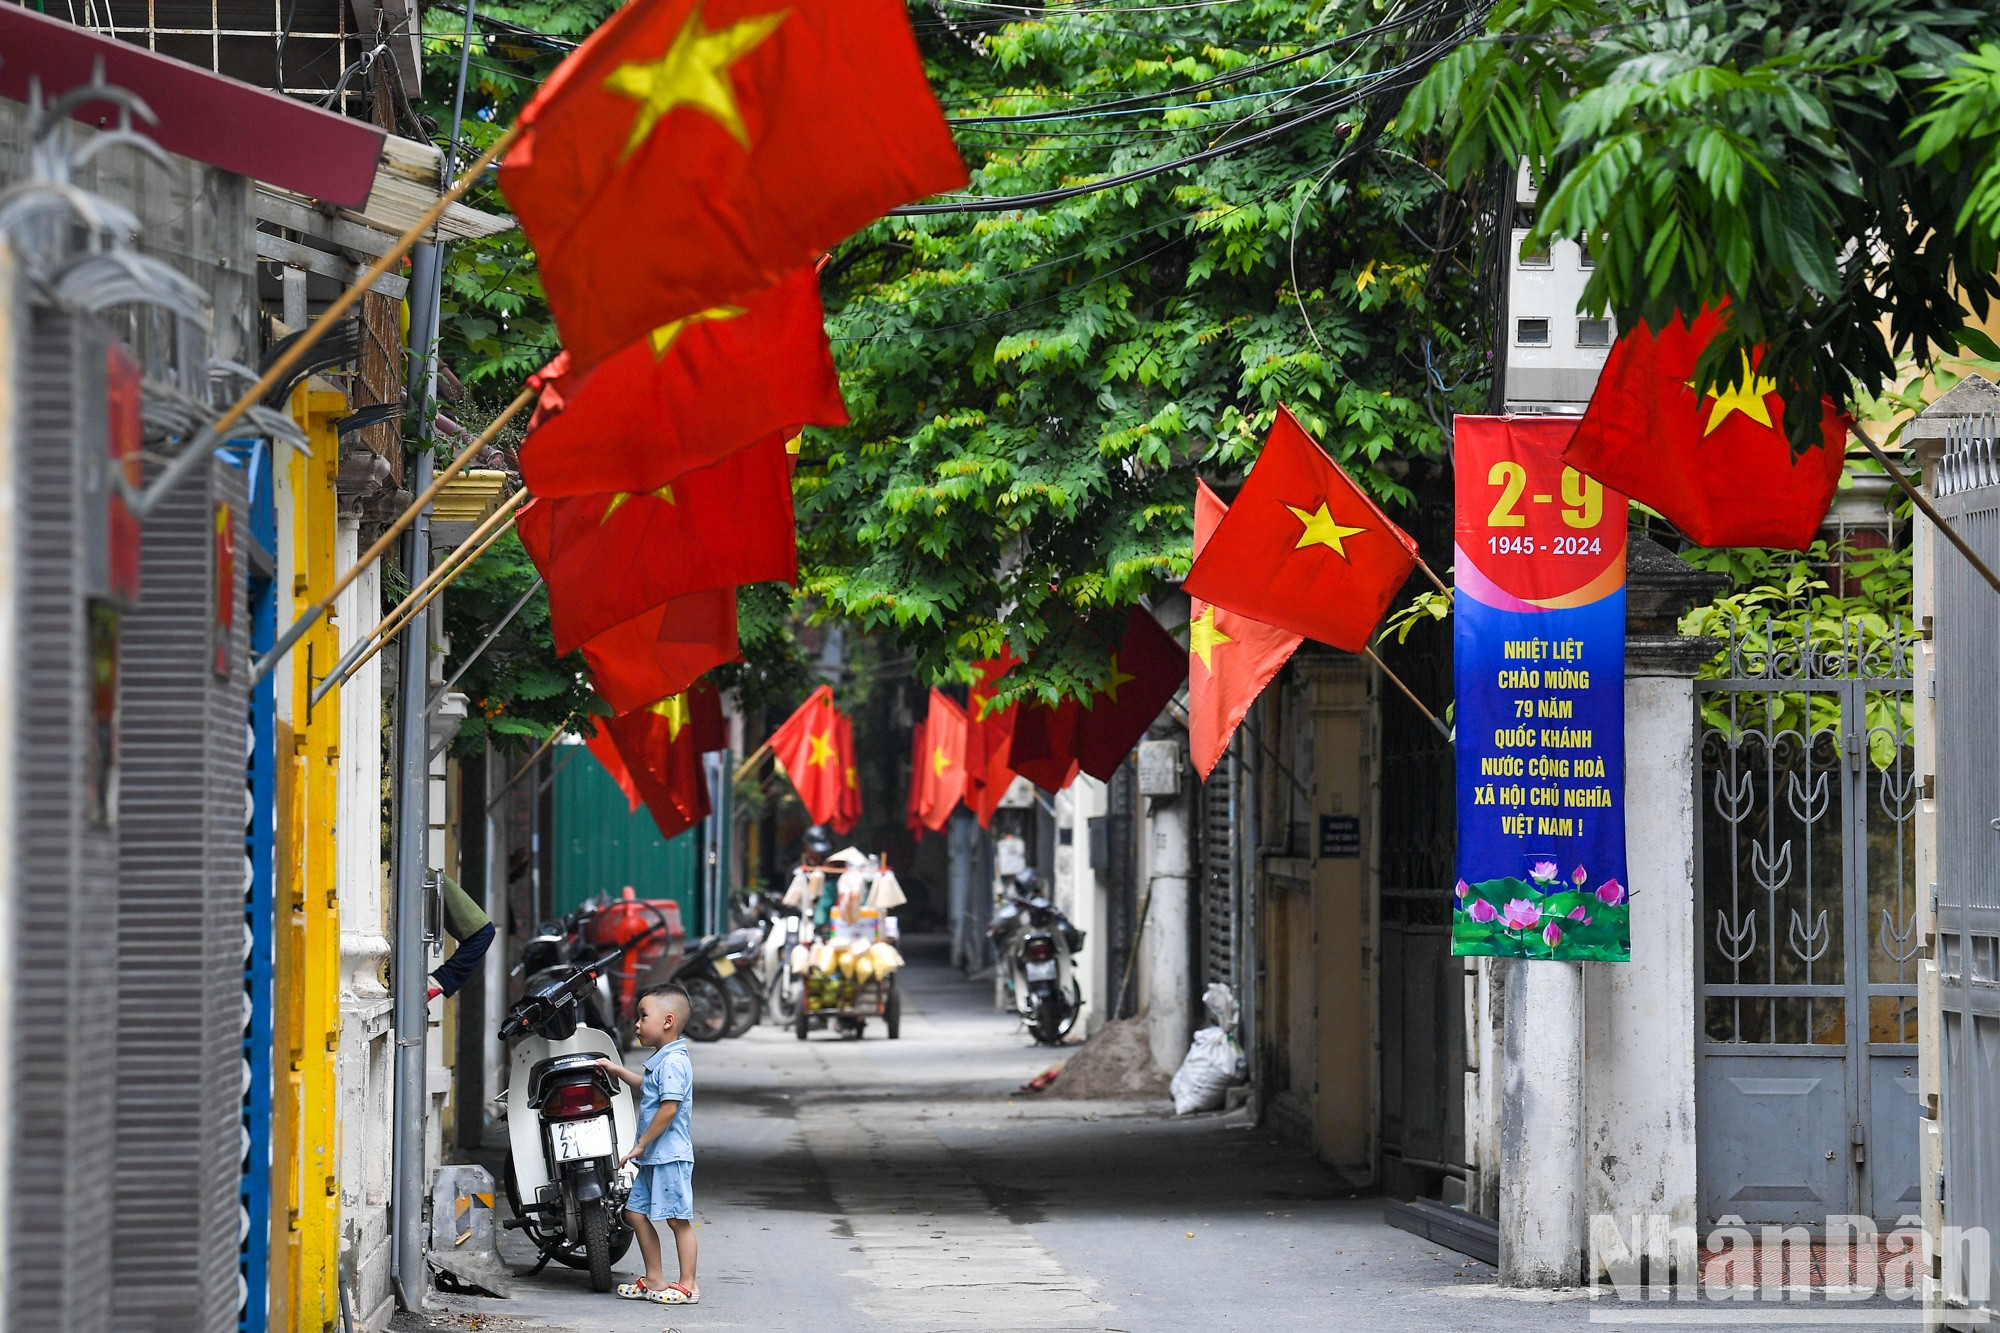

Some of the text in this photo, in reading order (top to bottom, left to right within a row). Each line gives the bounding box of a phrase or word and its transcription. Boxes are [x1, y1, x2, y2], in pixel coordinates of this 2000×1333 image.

[1487, 461, 1603, 529] 2-9
[1487, 536, 1535, 555] 1945
[1553, 536, 1602, 555] 2024
[1504, 637, 1584, 663] NHIỆT LIỆT
[1498, 666, 1590, 689] CHÀO MỪNG
[1514, 697, 1573, 718] 79 NĂM
[1495, 723, 1592, 749] QUỐC KHÁNH
[1481, 755, 1605, 780] NƯỚC CỘNG HOÀ
[1474, 783, 1612, 809] XÃ HỘI CHỦ NGHĨA
[1501, 813, 1584, 838] VIỆT NAM !
[554, 1056, 587, 1066] HONDA
